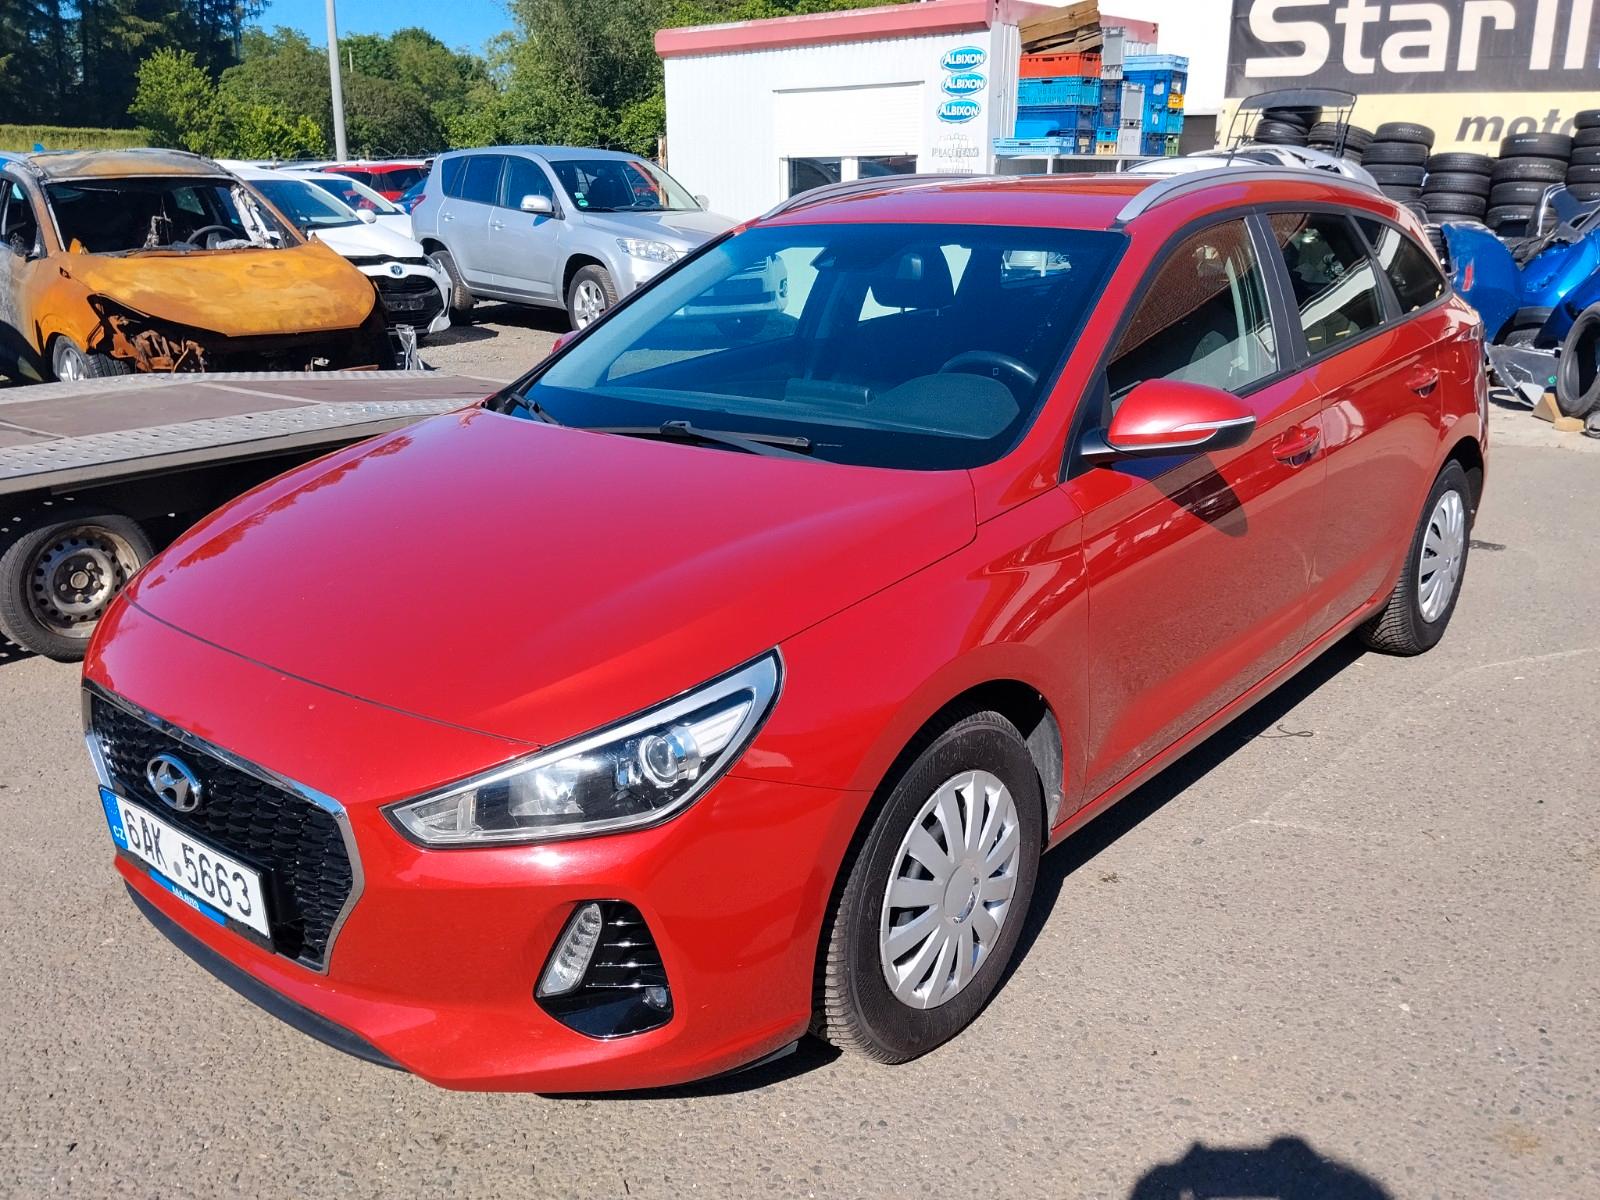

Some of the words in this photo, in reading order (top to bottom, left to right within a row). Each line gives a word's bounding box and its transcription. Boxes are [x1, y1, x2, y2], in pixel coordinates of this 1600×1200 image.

[943, 51, 984, 65] ALBIXON
[944, 77, 984, 89] ALBIXON
[938, 104, 979, 116] ALBIXON
[112, 824, 126, 841] CZ
[124, 809, 168, 870] 6AK
[181, 842, 252, 917] 5663
